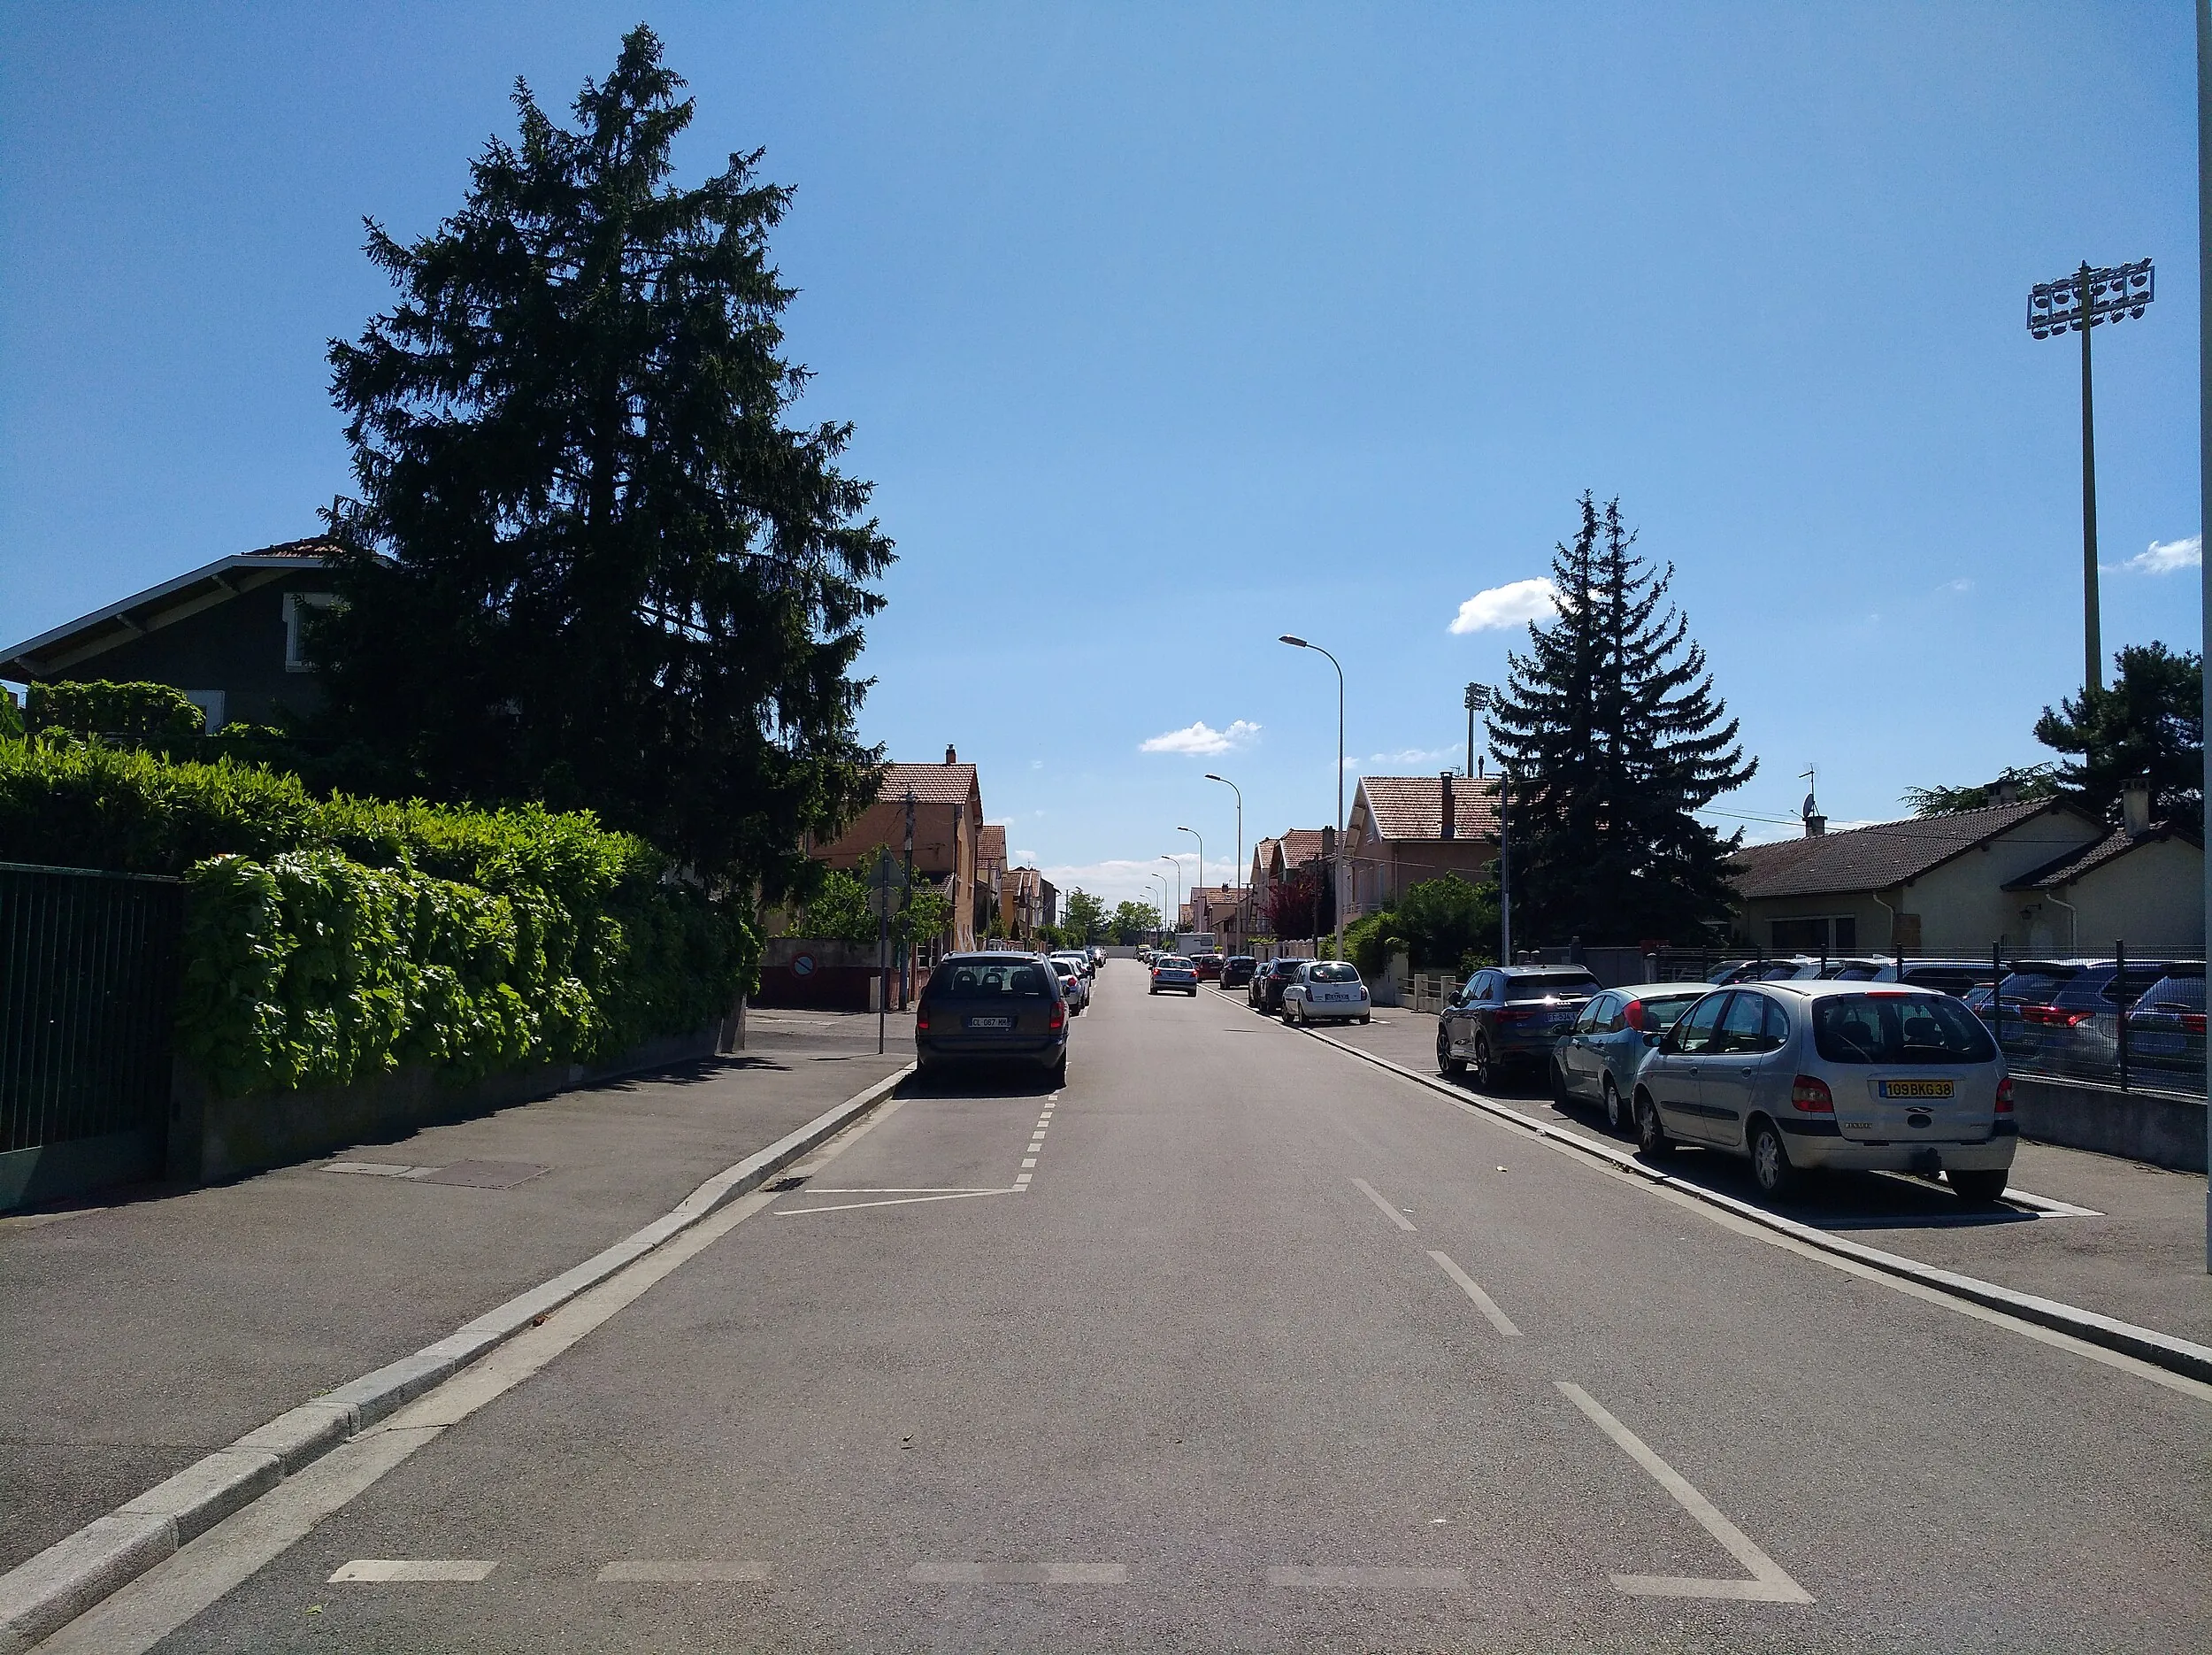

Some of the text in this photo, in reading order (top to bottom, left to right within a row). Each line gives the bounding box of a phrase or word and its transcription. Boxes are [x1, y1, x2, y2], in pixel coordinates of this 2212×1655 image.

[1887, 1083, 1952, 1096] 109 BKG 38
